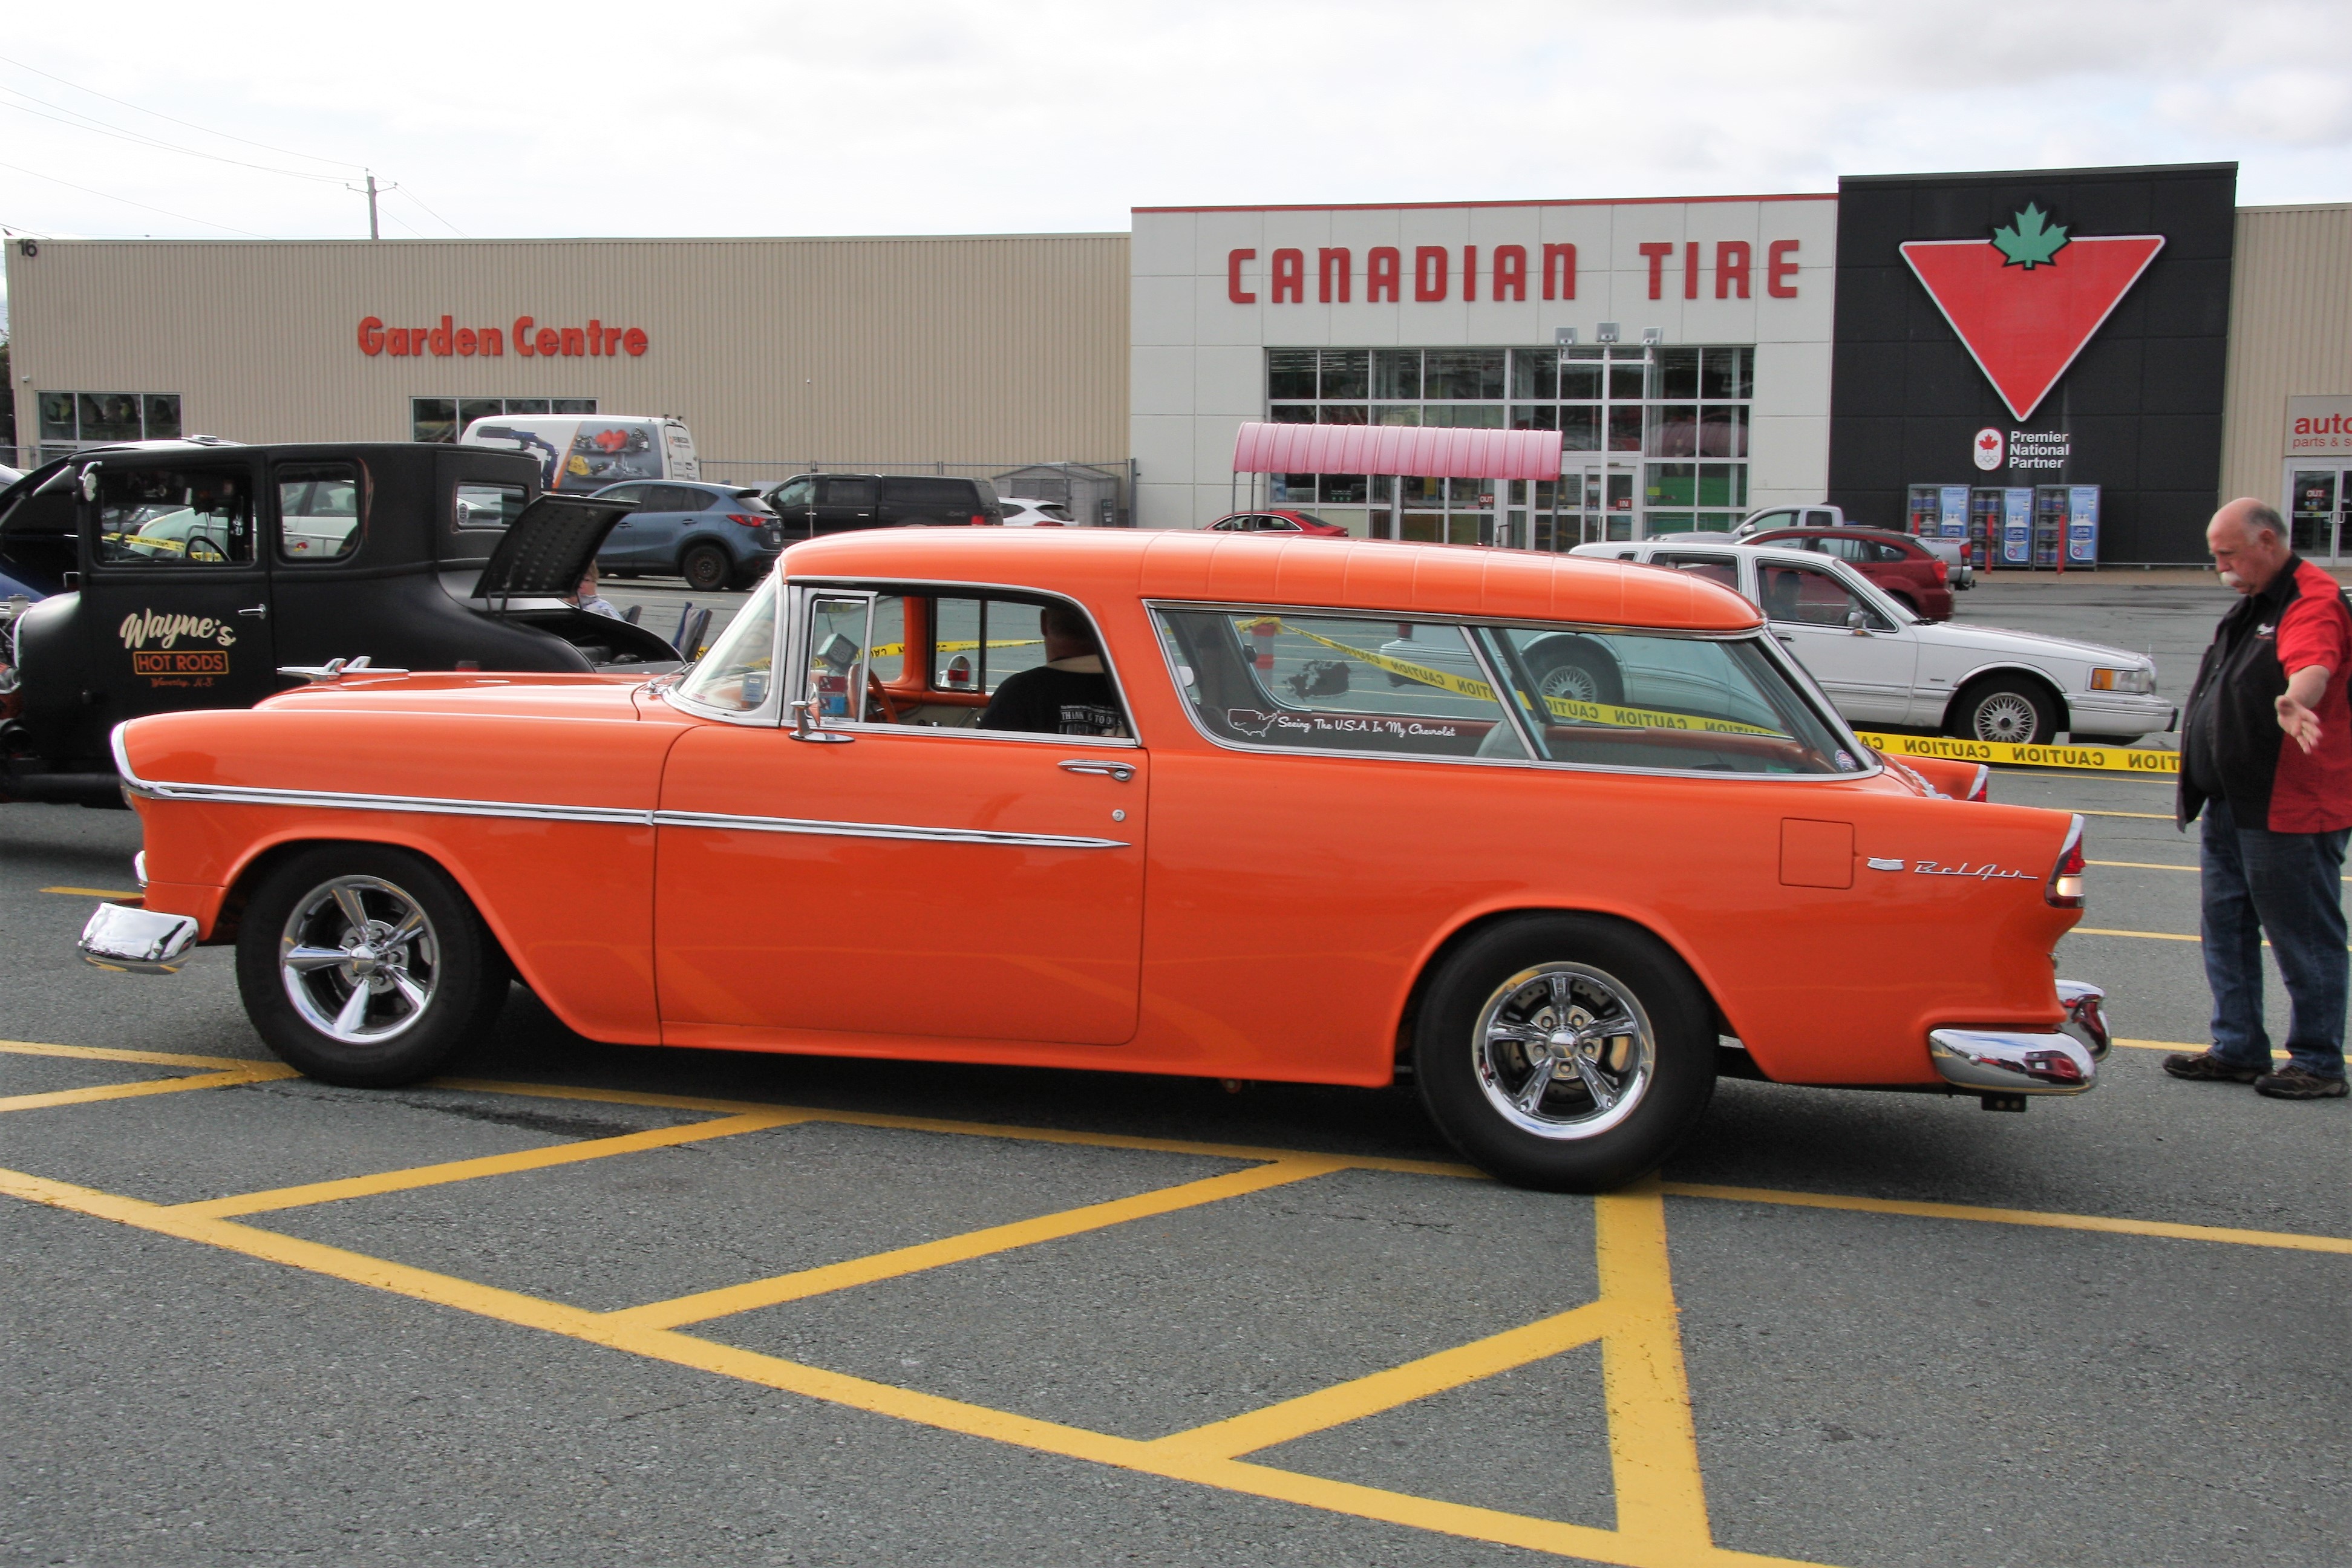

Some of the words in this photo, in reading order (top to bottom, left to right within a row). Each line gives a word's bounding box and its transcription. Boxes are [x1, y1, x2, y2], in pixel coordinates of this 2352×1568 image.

[17, 239, 38, 257] 16
[1229, 243, 1576, 303] CANADIAN
[1639, 240, 1800, 299] TIRE
[358, 315, 502, 356] Garden
[513, 316, 647, 356] Centre
[2010, 431, 2069, 443] Premier
[2293, 438, 2325, 449] parts
[2330, 438, 2339, 446] &
[2009, 444, 2069, 456] National
[2008, 457, 2064, 468] Partner
[120, 608, 237, 648] Wayne's
[137, 655, 171, 671] HOT
[176, 655, 223, 671] RODS
[1278, 717, 1312, 733] Seeing
[1314, 718, 1331, 730] The
[1373, 720, 1383, 733] In
[1387, 721, 1406, 737] My
[1408, 723, 1457, 737] Chevrolet
